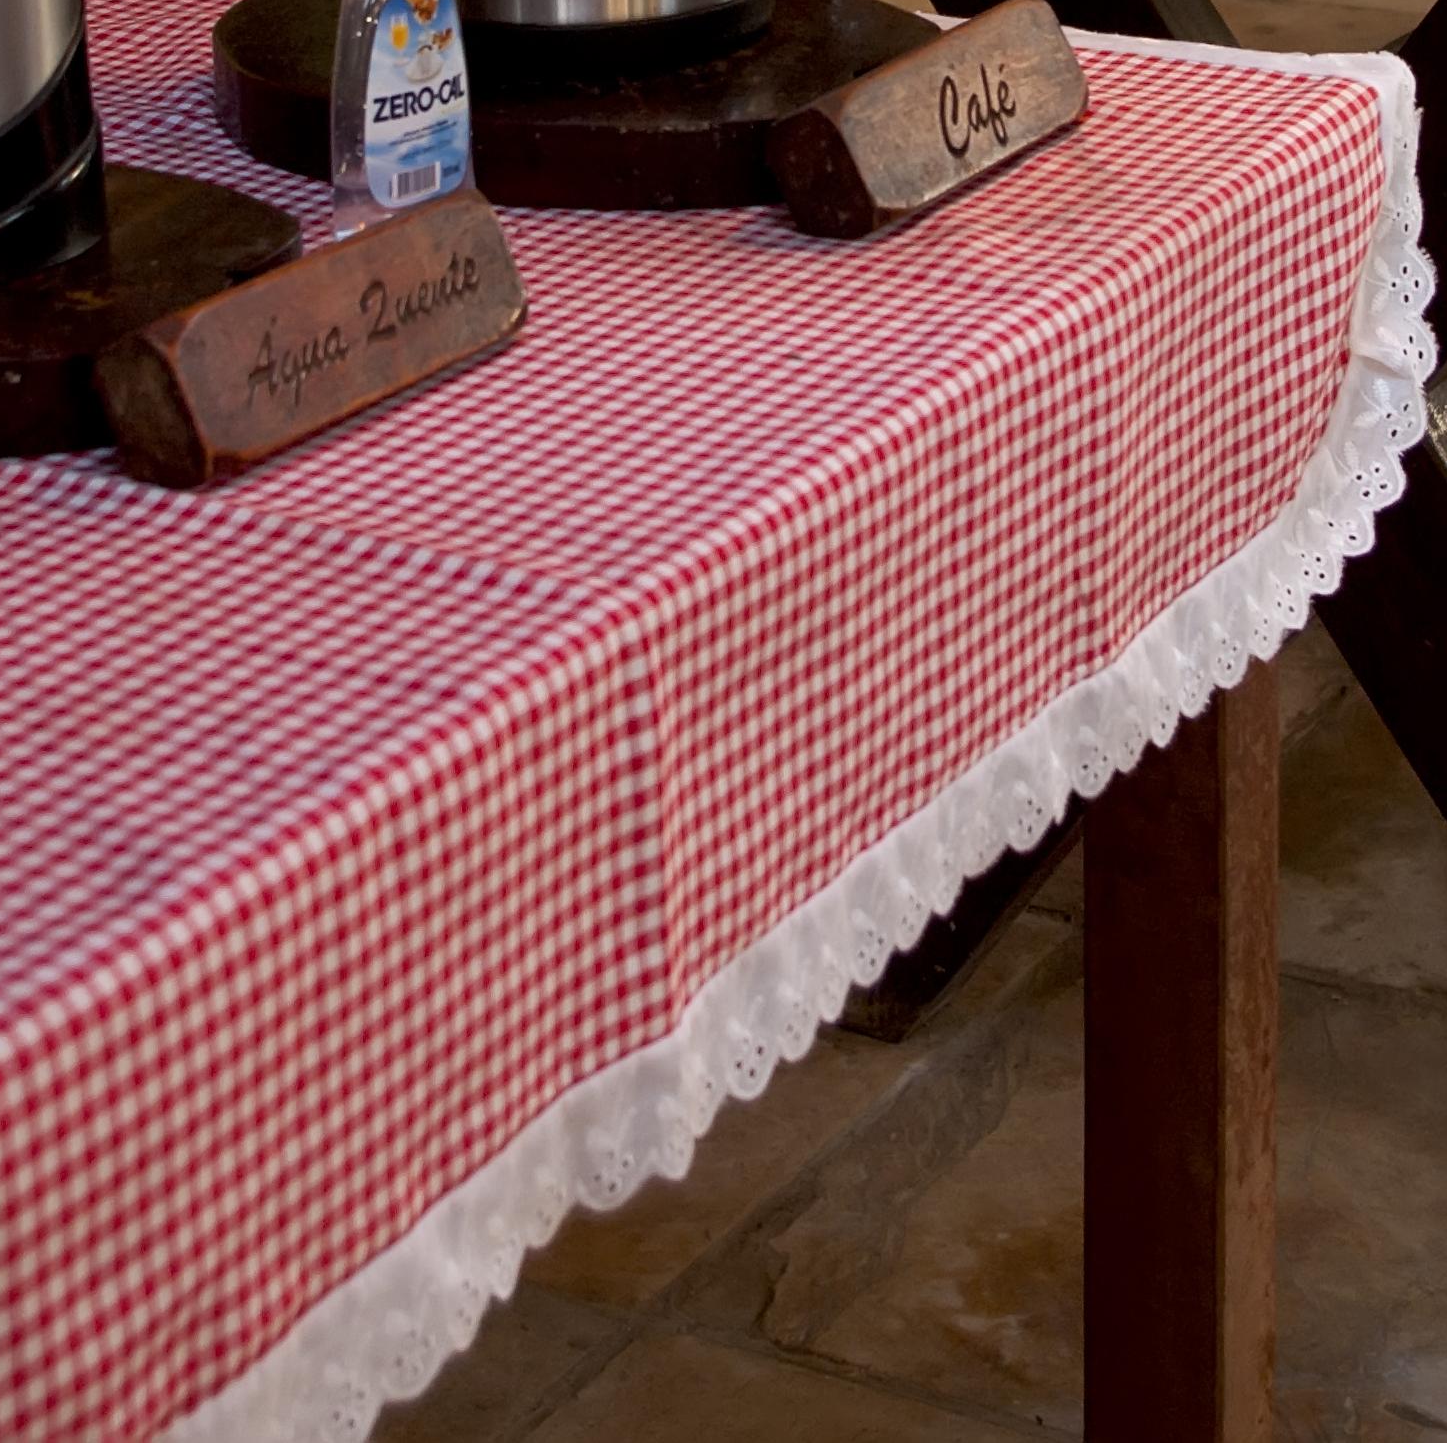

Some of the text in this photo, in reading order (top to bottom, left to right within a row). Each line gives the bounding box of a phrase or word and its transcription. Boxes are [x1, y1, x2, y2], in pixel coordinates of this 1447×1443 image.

[373, 73, 465, 123] ZERO-CAL
[939, 62, 1017, 158] Café
[246, 251, 481, 407] Água Quente
